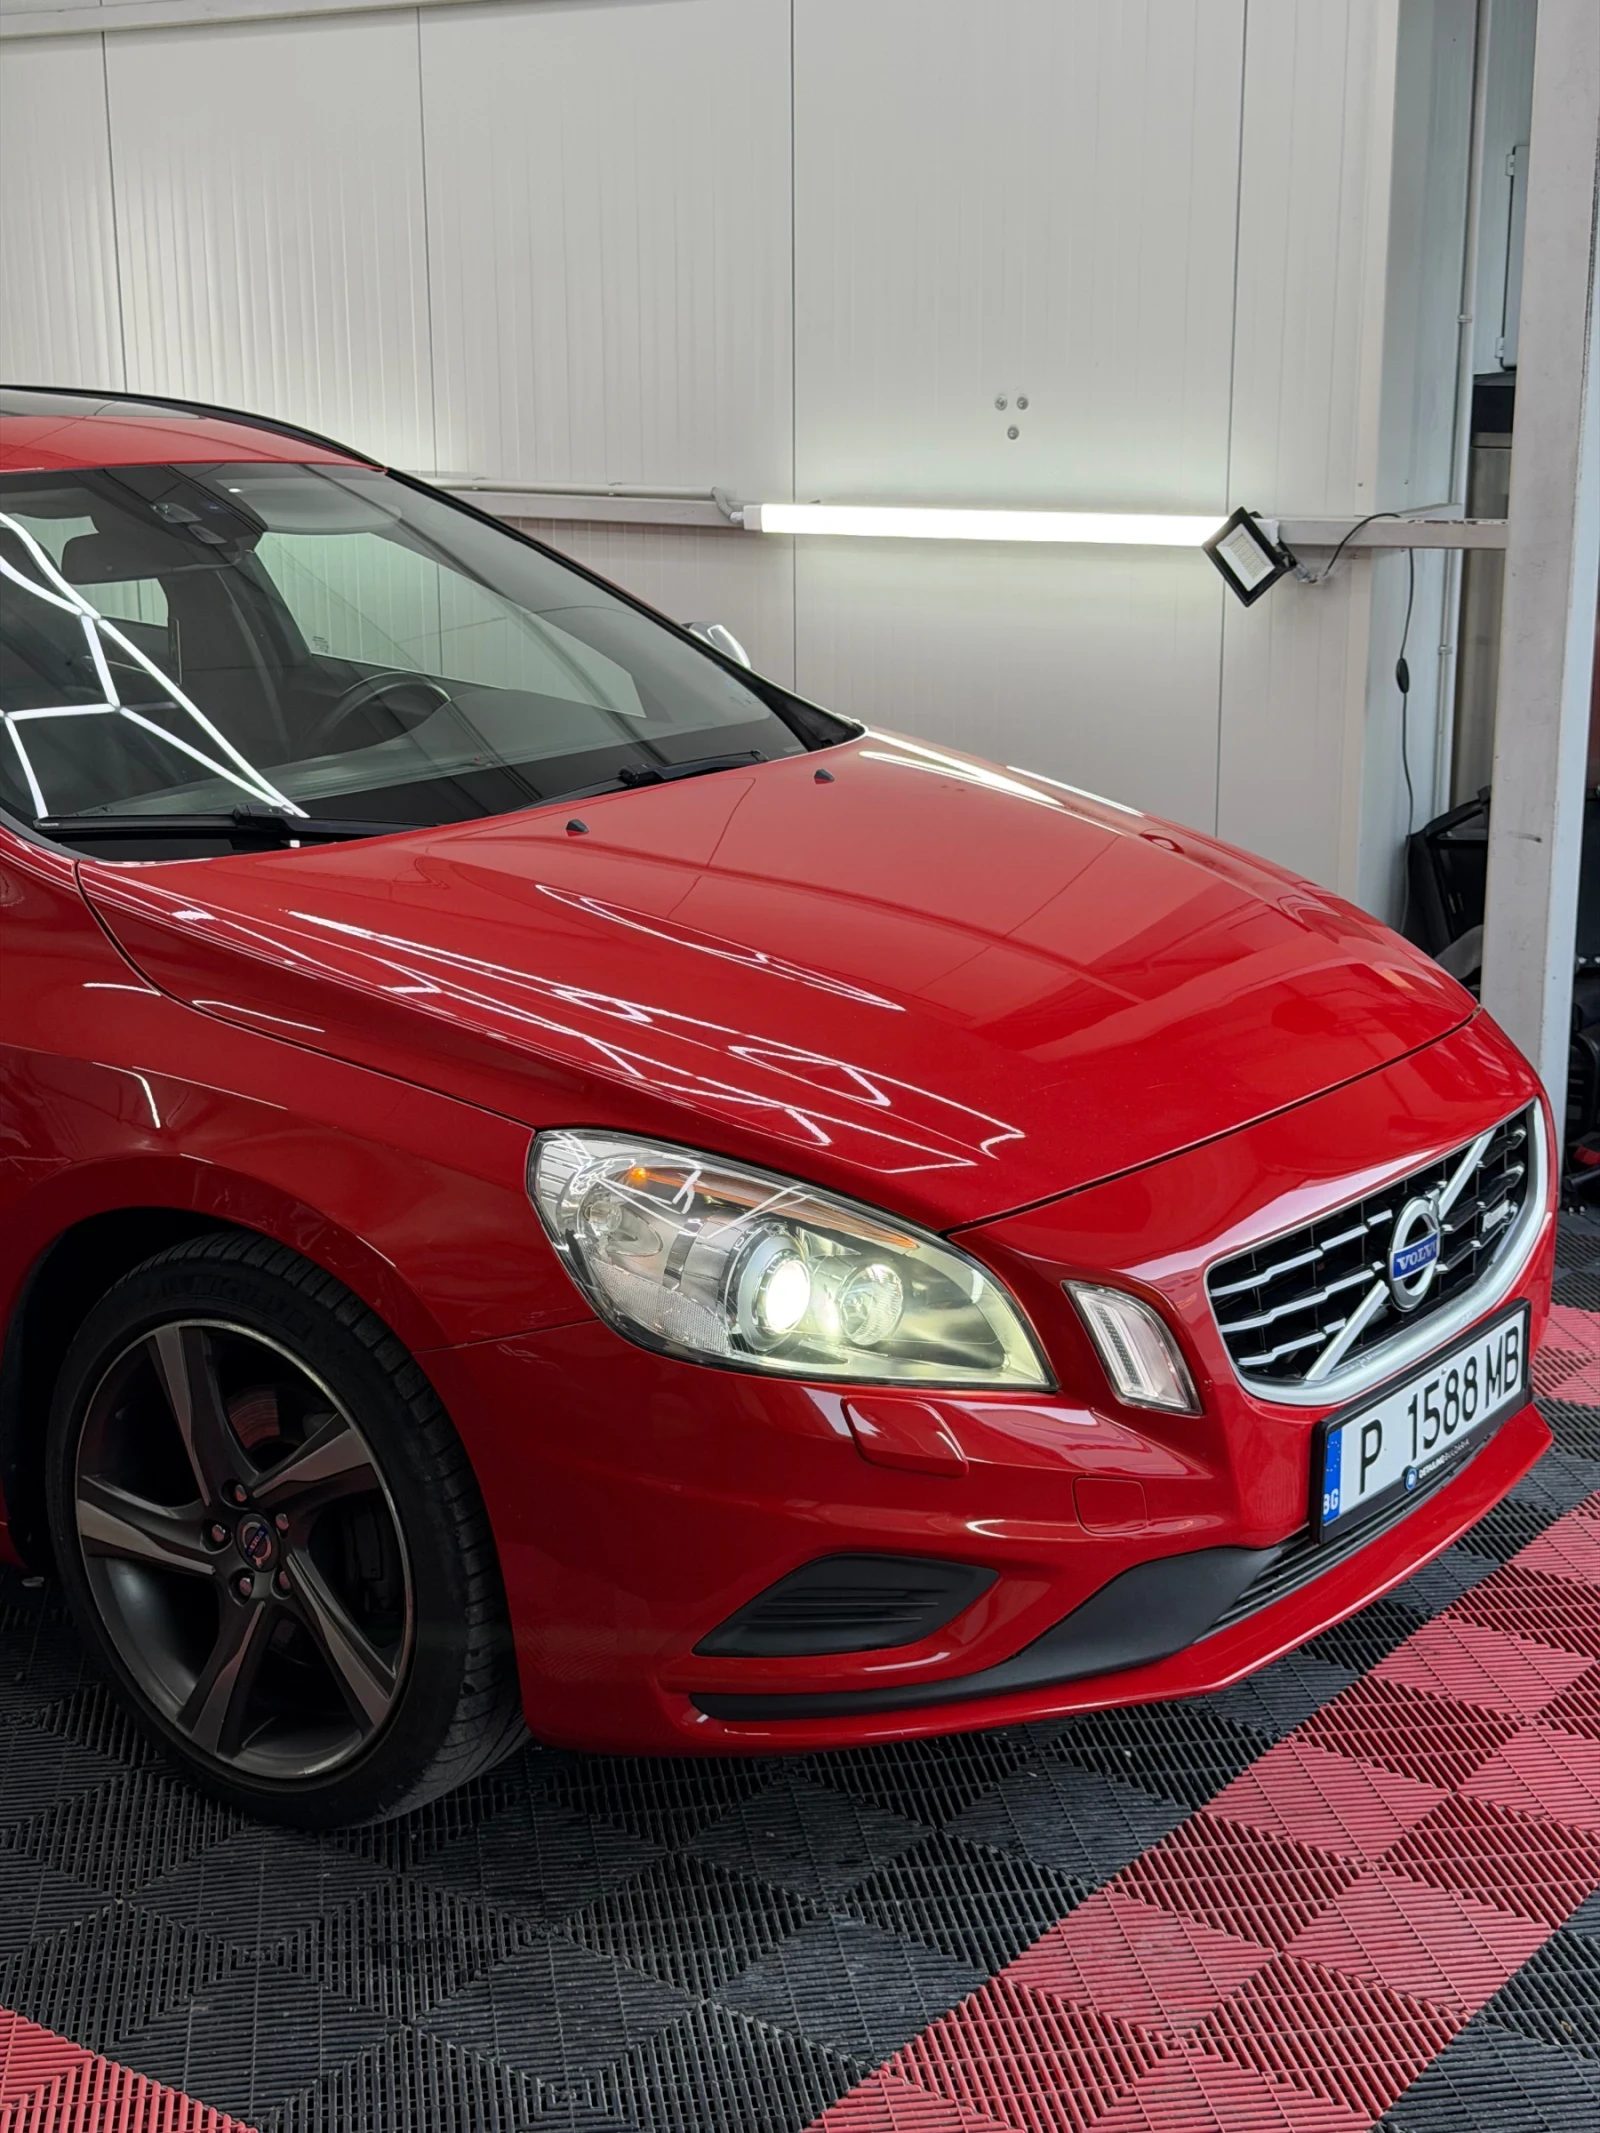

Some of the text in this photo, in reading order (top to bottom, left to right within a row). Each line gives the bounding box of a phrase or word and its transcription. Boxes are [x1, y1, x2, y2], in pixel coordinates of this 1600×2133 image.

[1358, 1325, 1519, 1496] P 1588 MB
[1323, 1488, 1339, 1515] BG
